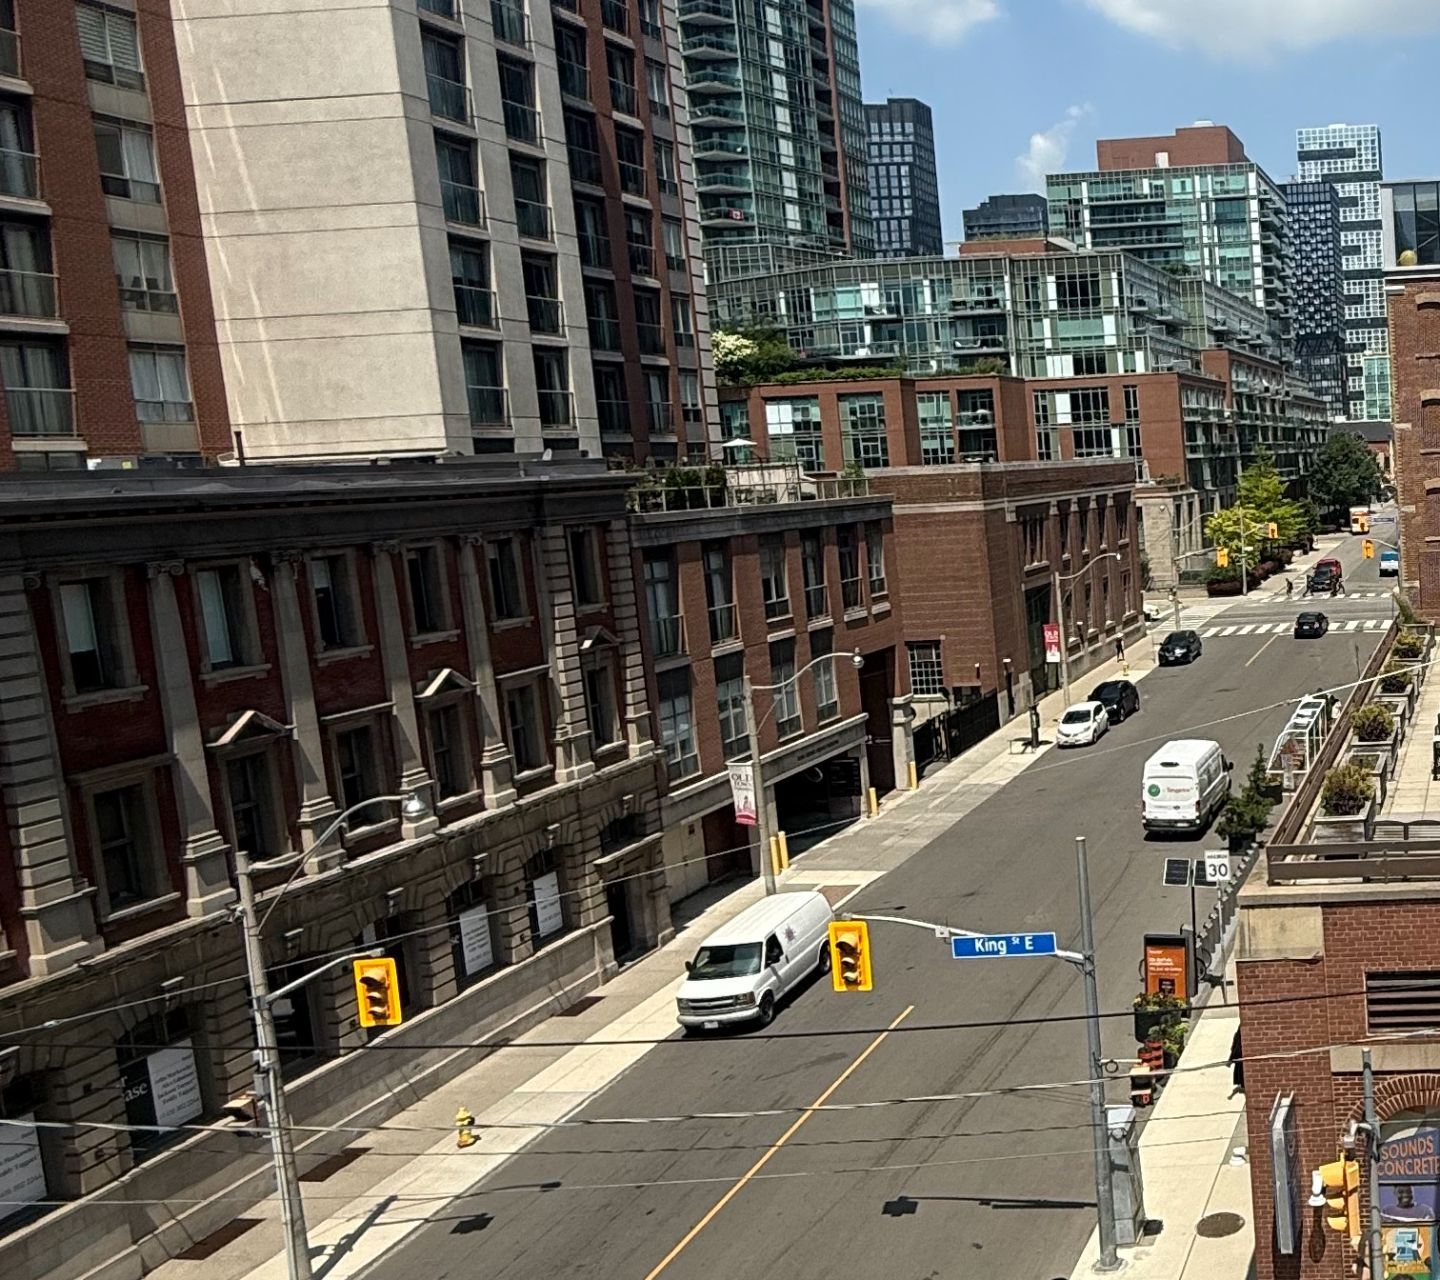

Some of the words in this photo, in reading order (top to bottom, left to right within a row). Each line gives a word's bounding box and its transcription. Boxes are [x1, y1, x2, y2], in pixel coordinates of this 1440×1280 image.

[1209, 863, 1228, 877] 30
[975, 938, 1007, 955] King
[1025, 936, 1034, 950] E
[1382, 1136, 1434, 1160] SOUNDS
[1377, 1155, 1440, 1176] CONCRETE
